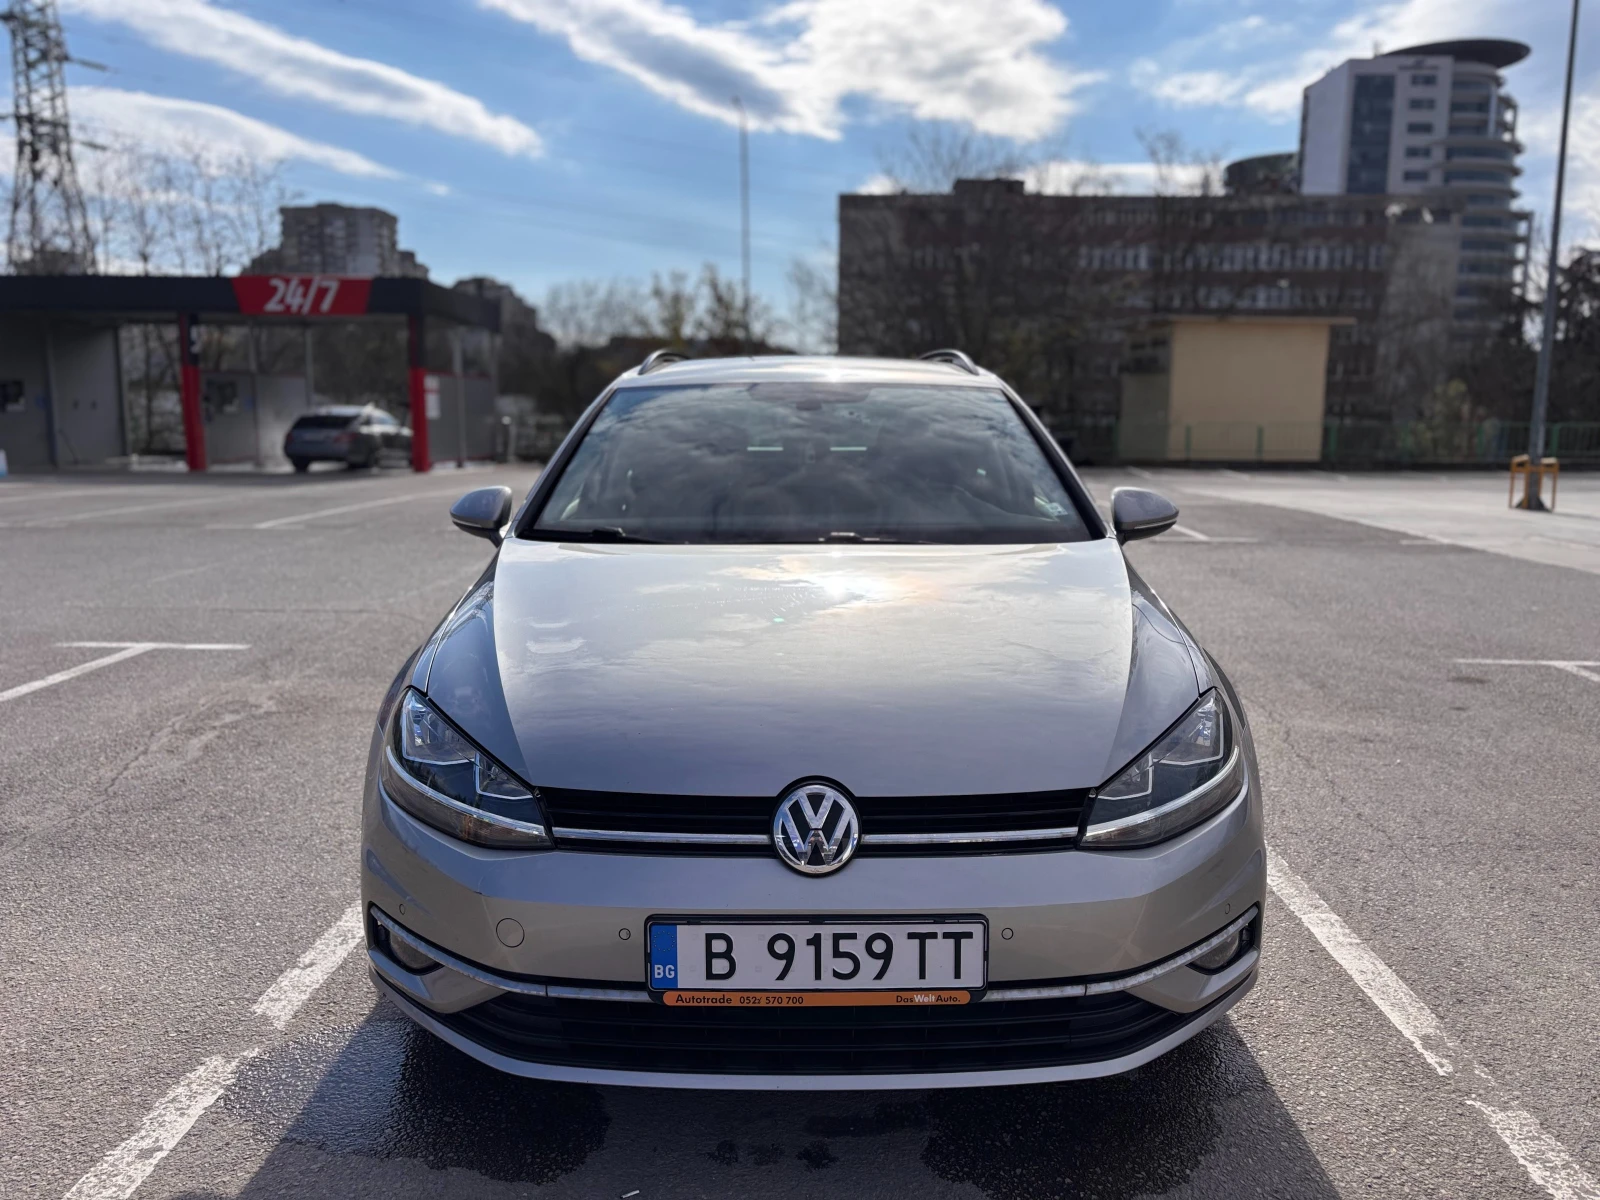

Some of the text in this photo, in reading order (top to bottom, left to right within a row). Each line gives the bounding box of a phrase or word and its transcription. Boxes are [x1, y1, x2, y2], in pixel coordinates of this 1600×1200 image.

[263, 276, 341, 315] 24/7
[705, 931, 974, 981] B 9159 TT
[654, 965, 675, 979] BG
[675, 994, 733, 1005] Autotrade
[765, 996, 783, 1005] 570
[785, 996, 804, 1005] 700
